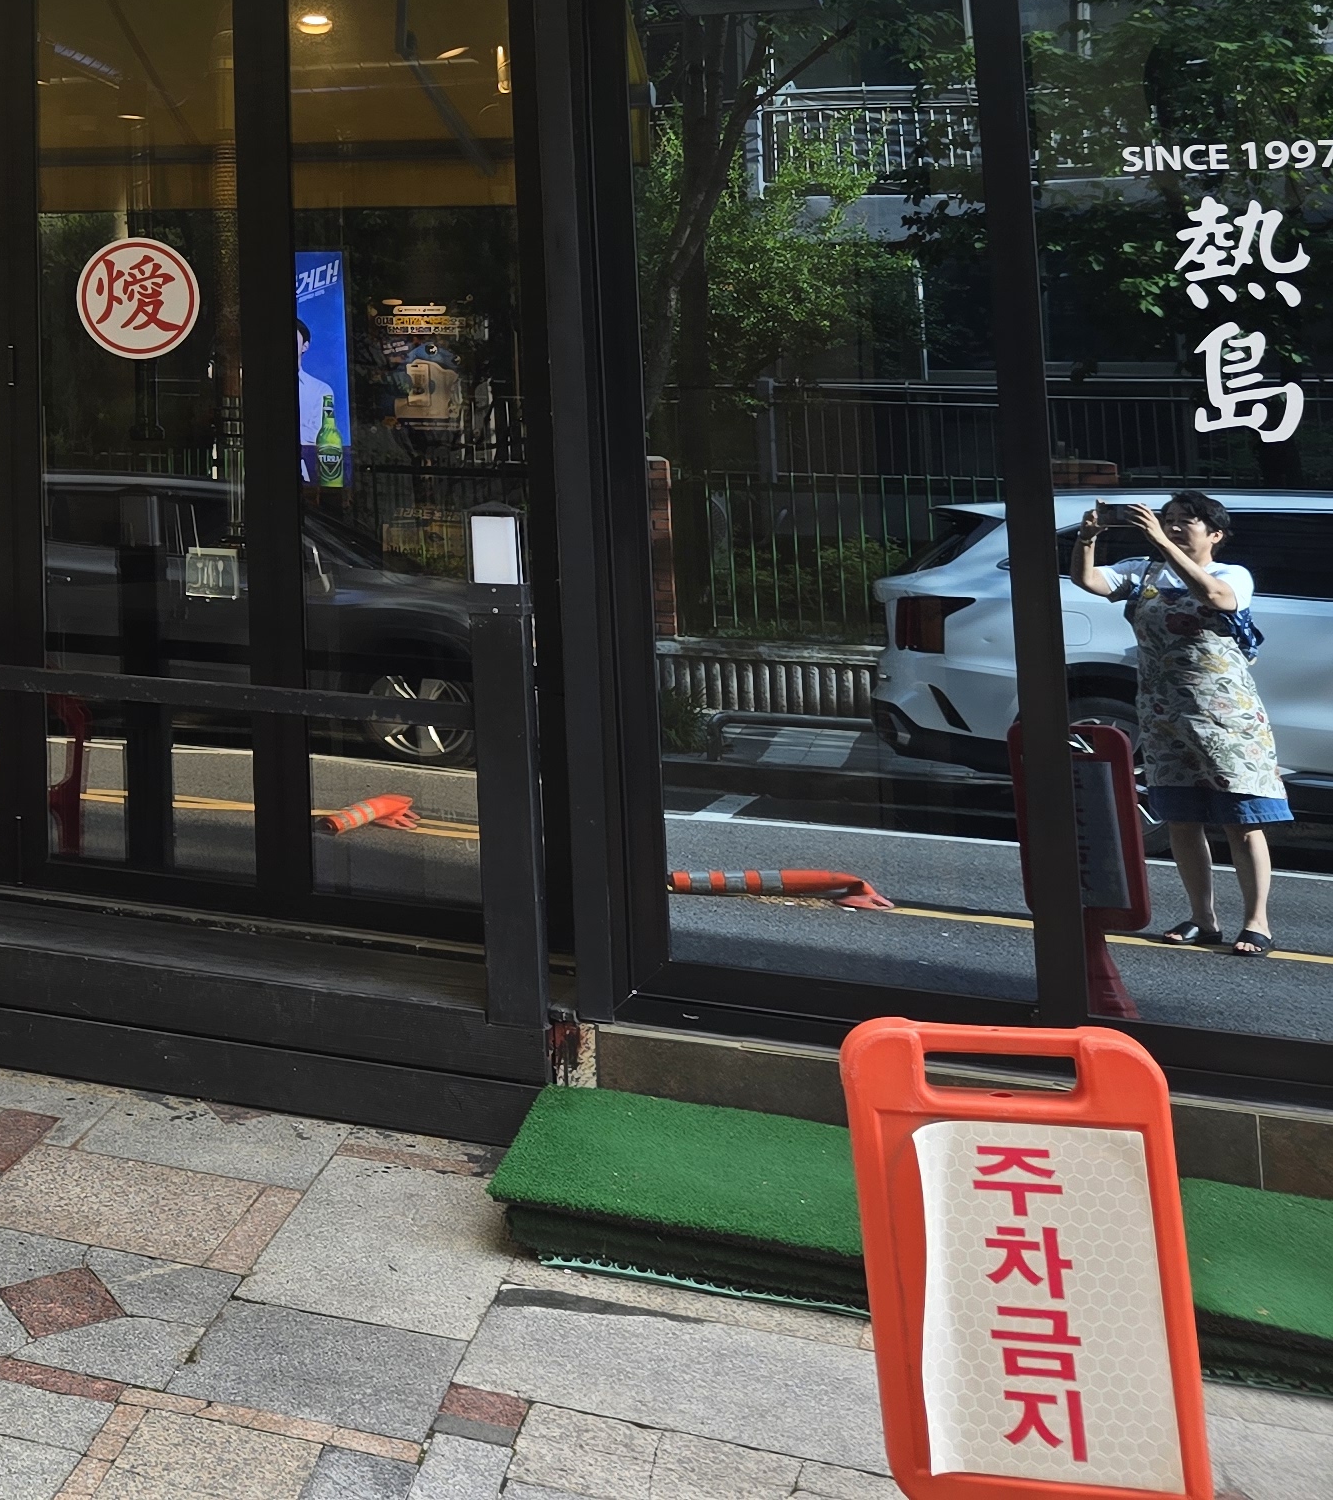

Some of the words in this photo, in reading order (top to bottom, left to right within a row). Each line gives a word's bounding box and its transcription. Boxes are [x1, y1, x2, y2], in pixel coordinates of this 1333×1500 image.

[1122, 143, 1230, 173] SINCE
[1241, 139, 1333, 171] 1997
[296, 260, 340, 295] 거다!
[973, 1145, 1089, 1463] 주차금지
